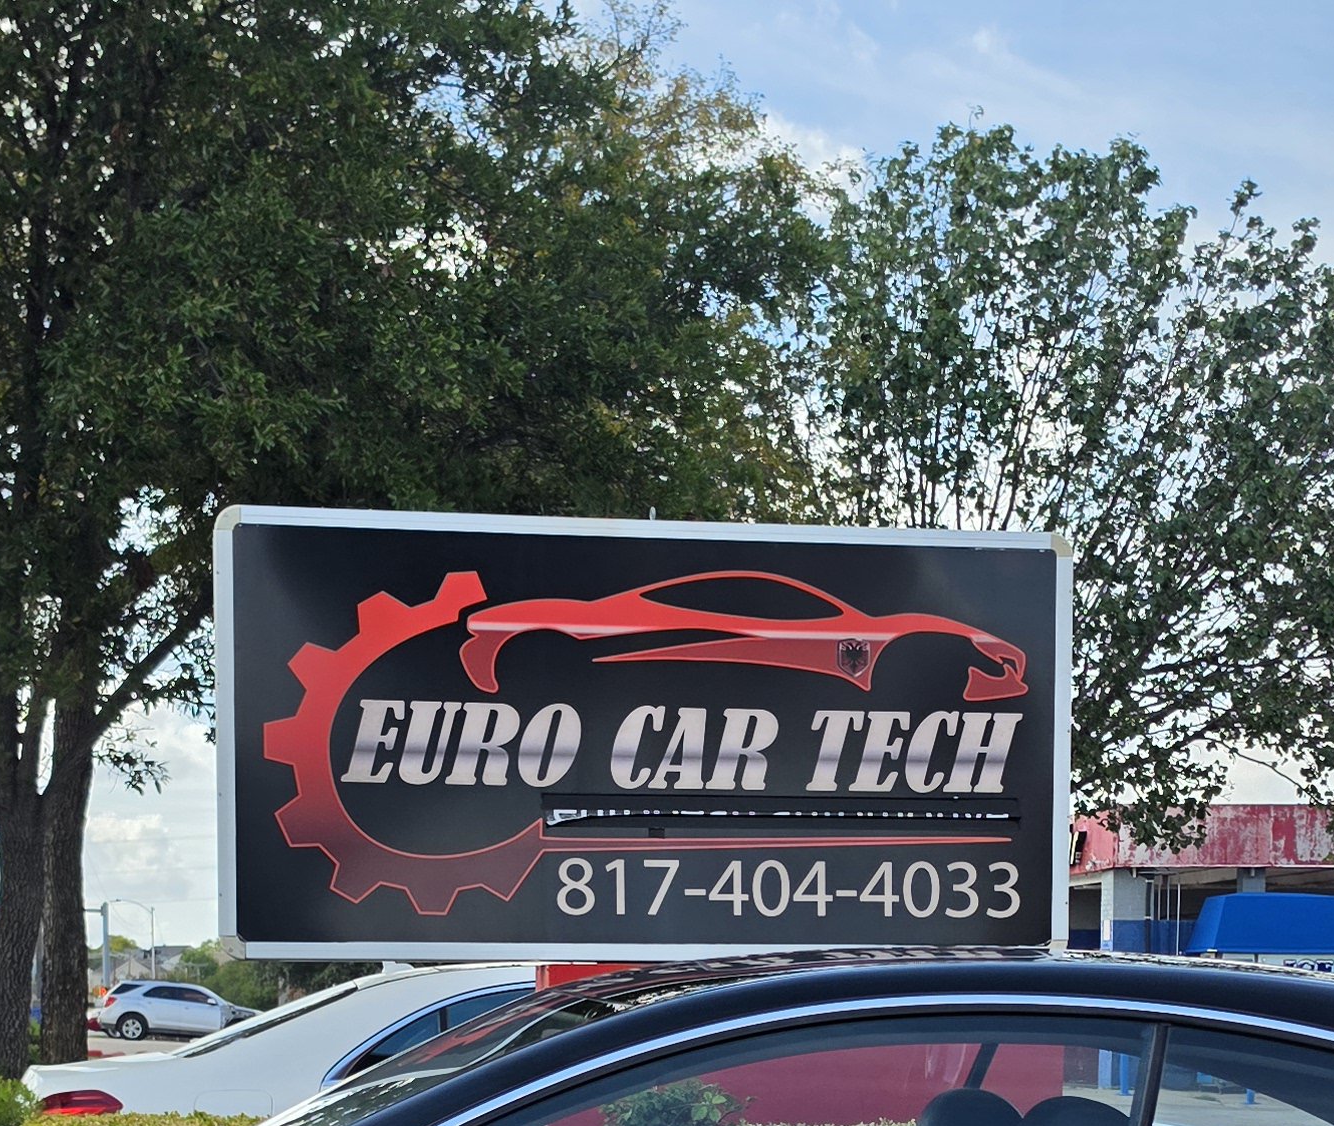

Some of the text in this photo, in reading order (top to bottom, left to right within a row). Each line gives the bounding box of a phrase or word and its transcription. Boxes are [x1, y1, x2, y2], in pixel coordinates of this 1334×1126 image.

[340, 699, 1024, 793] EURO CAR TECH
[556, 857, 1021, 919] 817-404-4033
